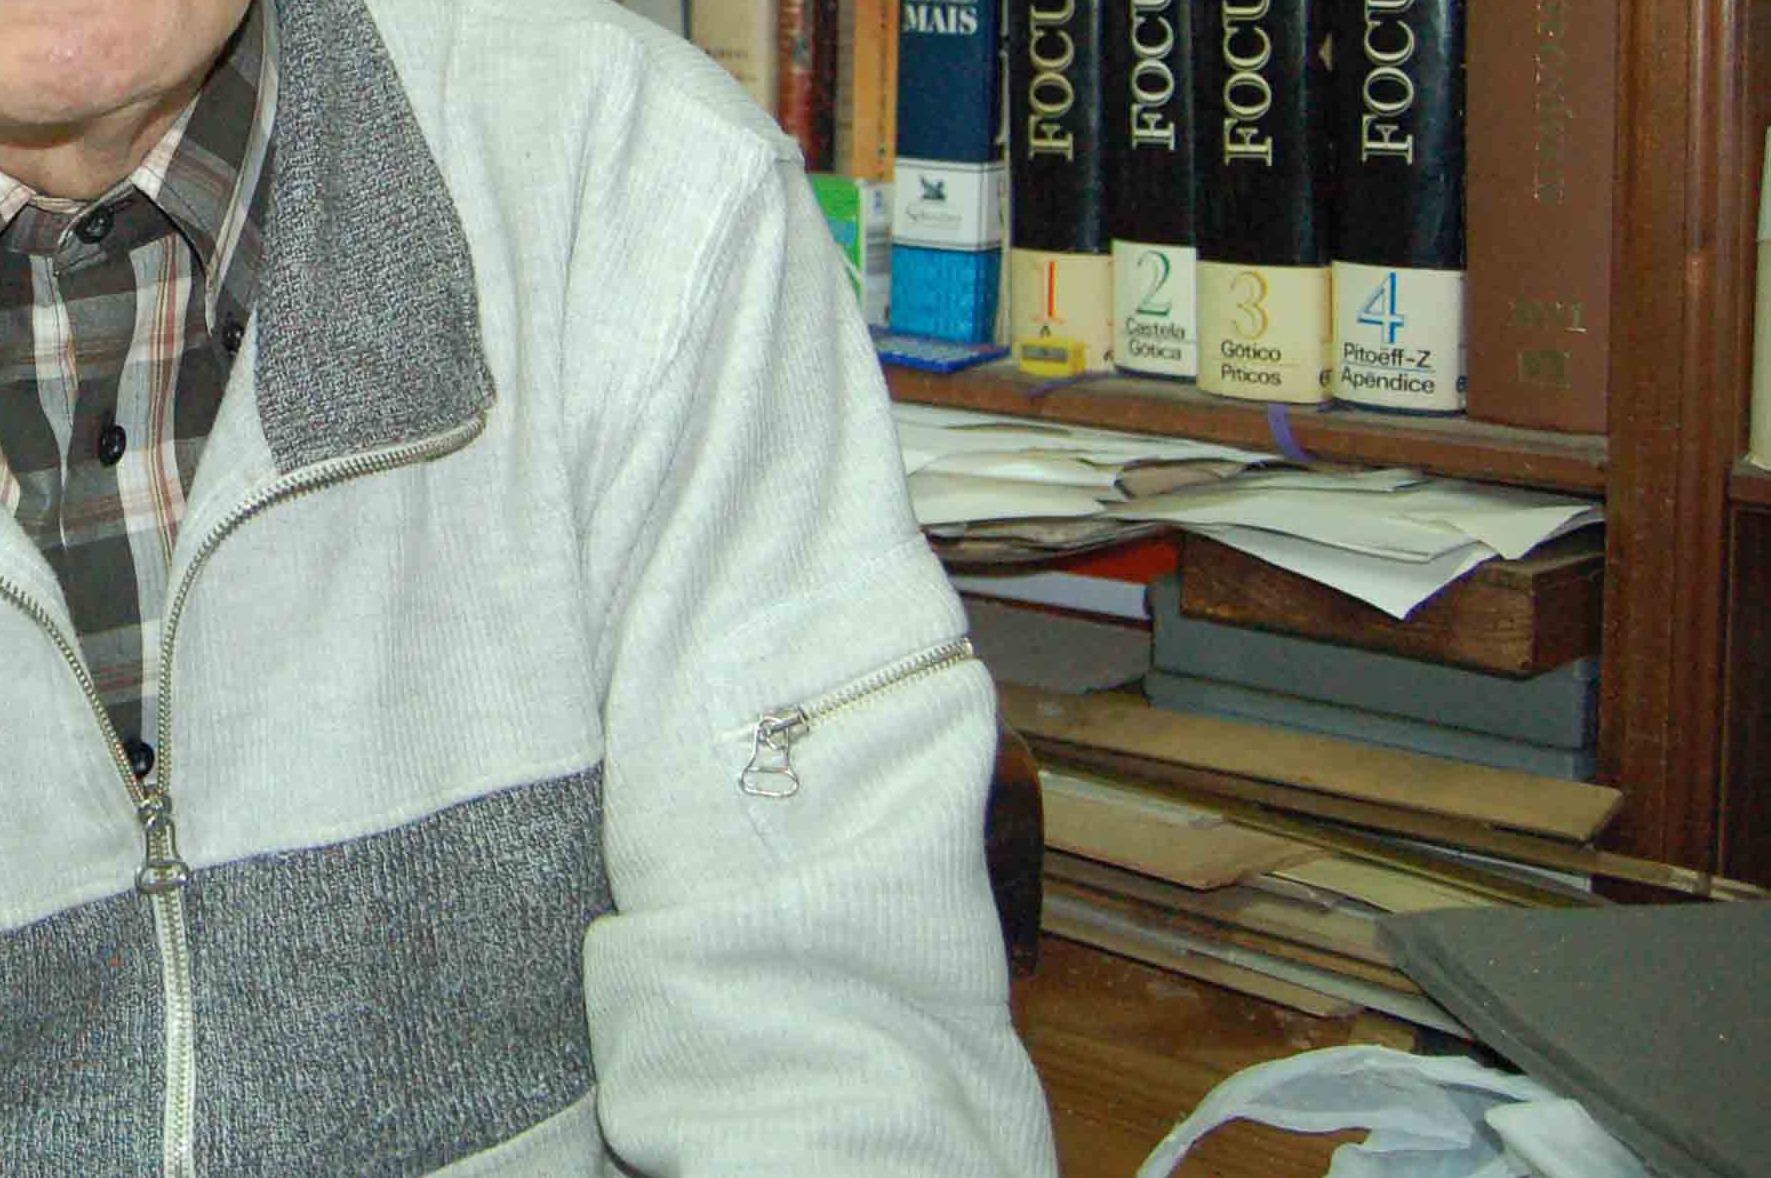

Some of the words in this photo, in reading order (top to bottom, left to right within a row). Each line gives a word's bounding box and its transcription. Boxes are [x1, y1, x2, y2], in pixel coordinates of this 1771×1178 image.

[902, 4, 979, 35] MAIS
[1031, 260, 1066, 326] 1
[1135, 249, 1174, 316] 2
[1229, 270, 1269, 342] 3
[1355, 271, 1405, 344] 4
[1125, 317, 1186, 341] Castela
